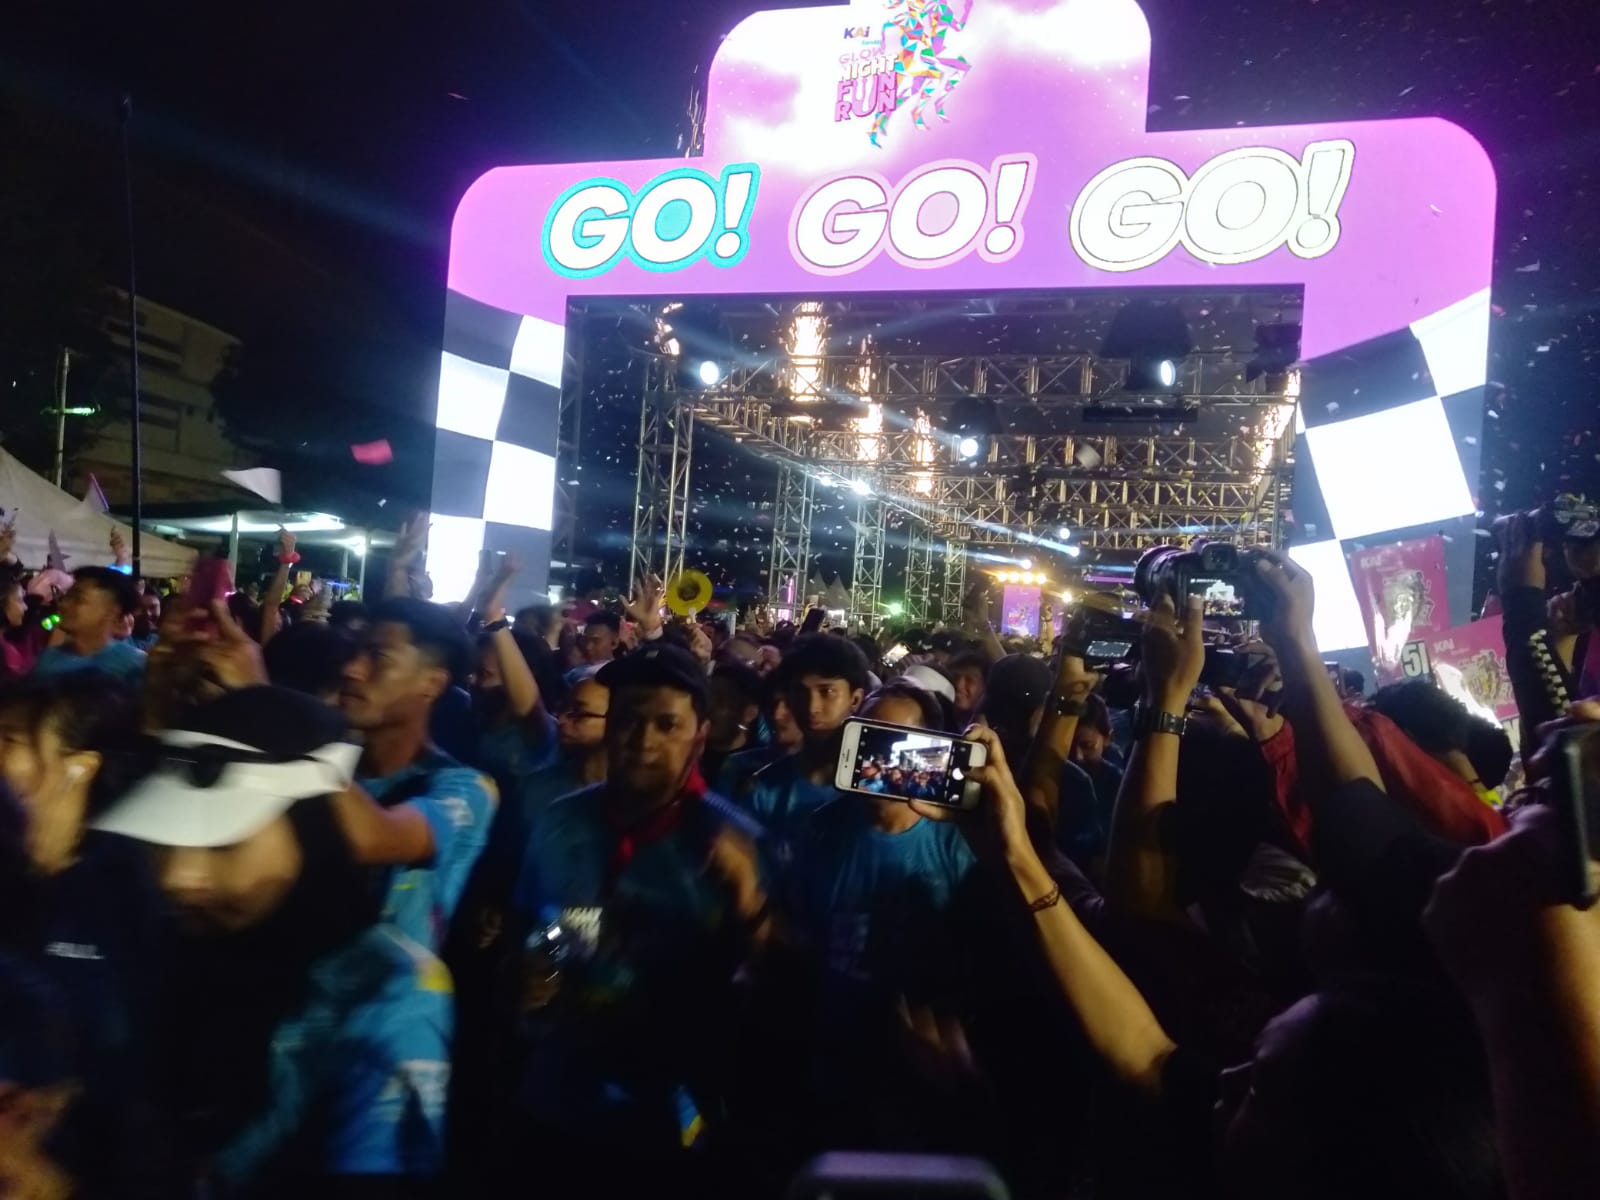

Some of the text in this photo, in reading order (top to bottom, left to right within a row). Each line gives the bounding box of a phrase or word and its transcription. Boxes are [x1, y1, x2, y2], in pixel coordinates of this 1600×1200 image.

[841, 55, 899, 82] NIGHT
[834, 88, 898, 122] RUN
[837, 71, 898, 105] FUN
[545, 141, 1353, 275] GO! GO! GO!
